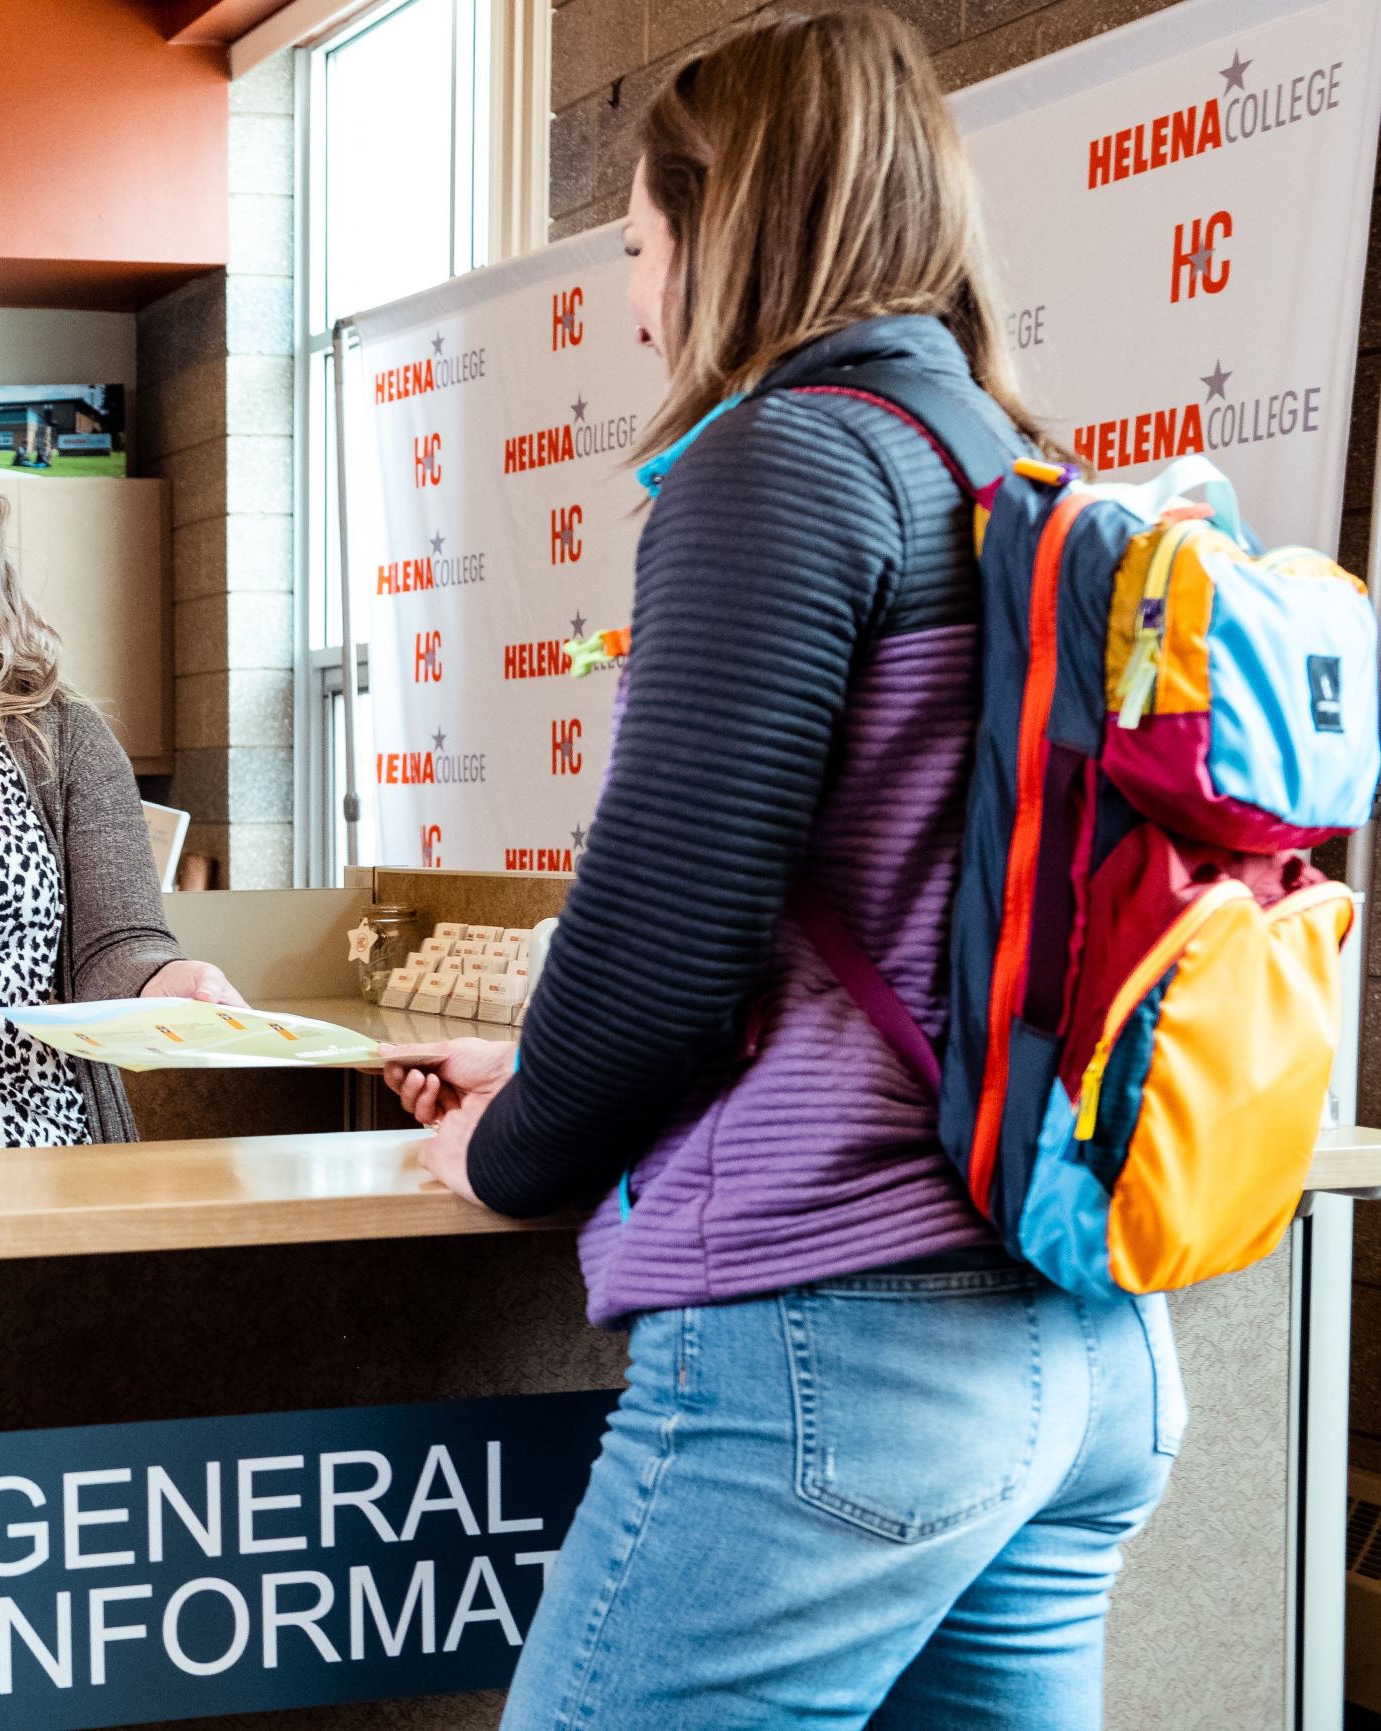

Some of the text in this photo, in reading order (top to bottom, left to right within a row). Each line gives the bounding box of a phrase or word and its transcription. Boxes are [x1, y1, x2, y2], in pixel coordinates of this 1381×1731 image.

[1088, 61, 1343, 190] HELENA COLLEGE
[1170, 210, 1233, 304] HC
[552, 287, 583, 351] HC
[375, 348, 486, 405] HELENA COLLEGE
[504, 414, 637, 474] HELENA COLLEGE
[1074, 387, 1321, 472] HELENA COLLEGE
[414, 432, 441, 488] HC
[551, 504, 583, 565] HC
[434, 553, 485, 588] COLLEGE
[415, 629, 442, 684] HC
[435, 754, 486, 783] COLLEGE
[551, 718, 582, 775] HC
